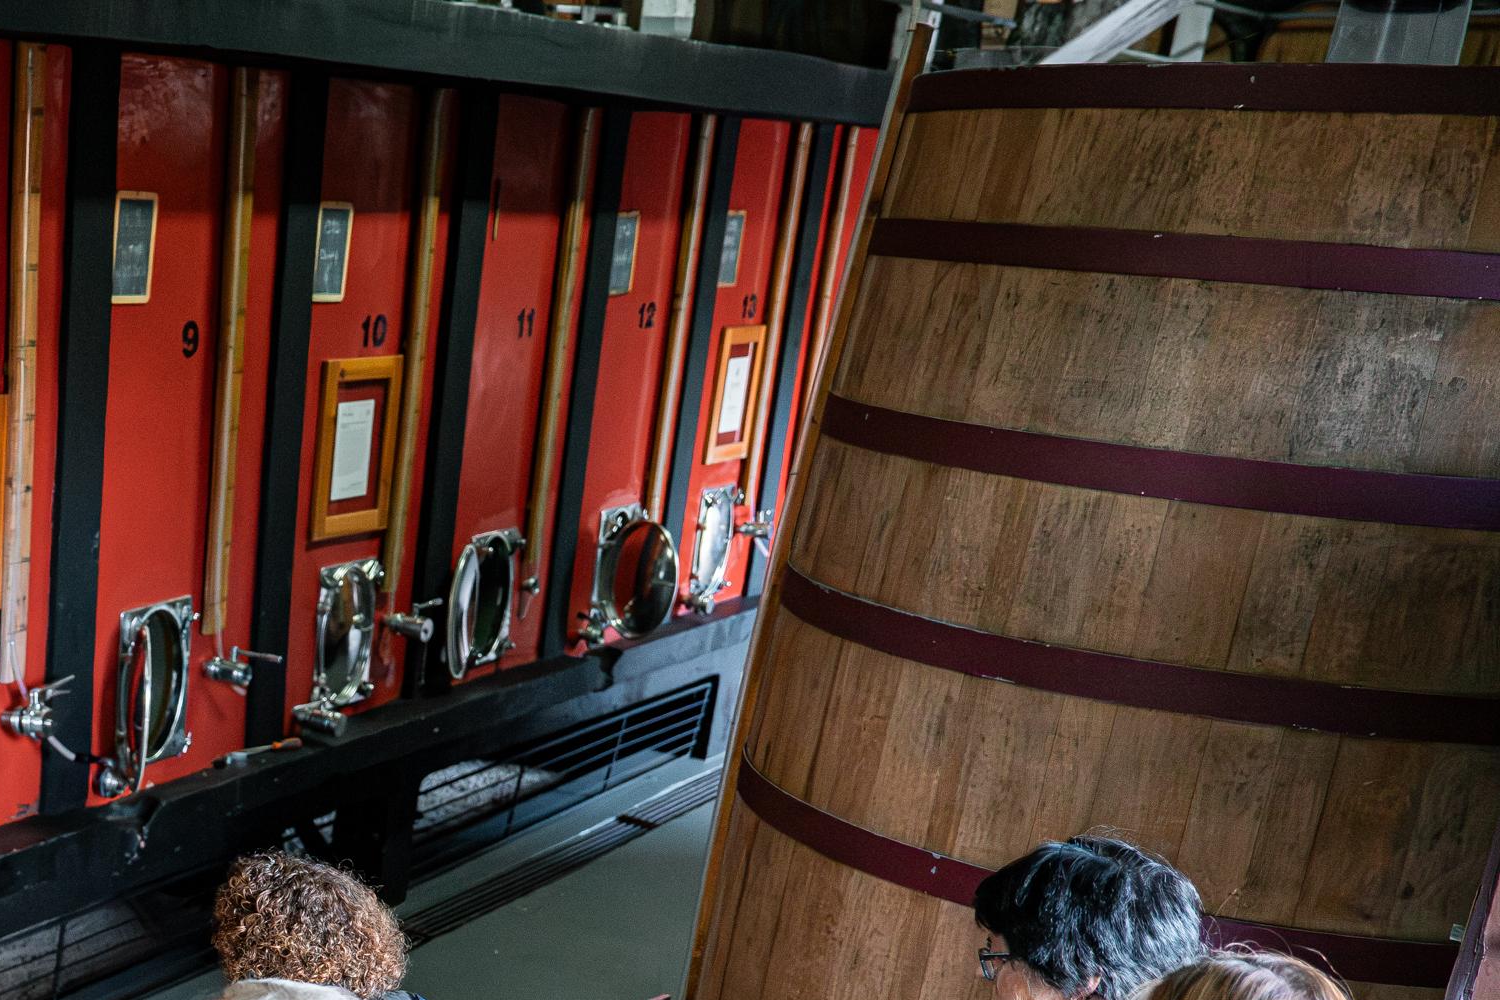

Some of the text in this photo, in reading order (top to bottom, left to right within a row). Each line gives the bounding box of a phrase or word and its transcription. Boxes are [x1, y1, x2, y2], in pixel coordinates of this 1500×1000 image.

[638, 302, 656, 329] 12
[742, 293, 757, 319] 13
[182, 321, 199, 358] 9
[361, 314, 387, 348] 10
[517, 308, 535, 340] 11
